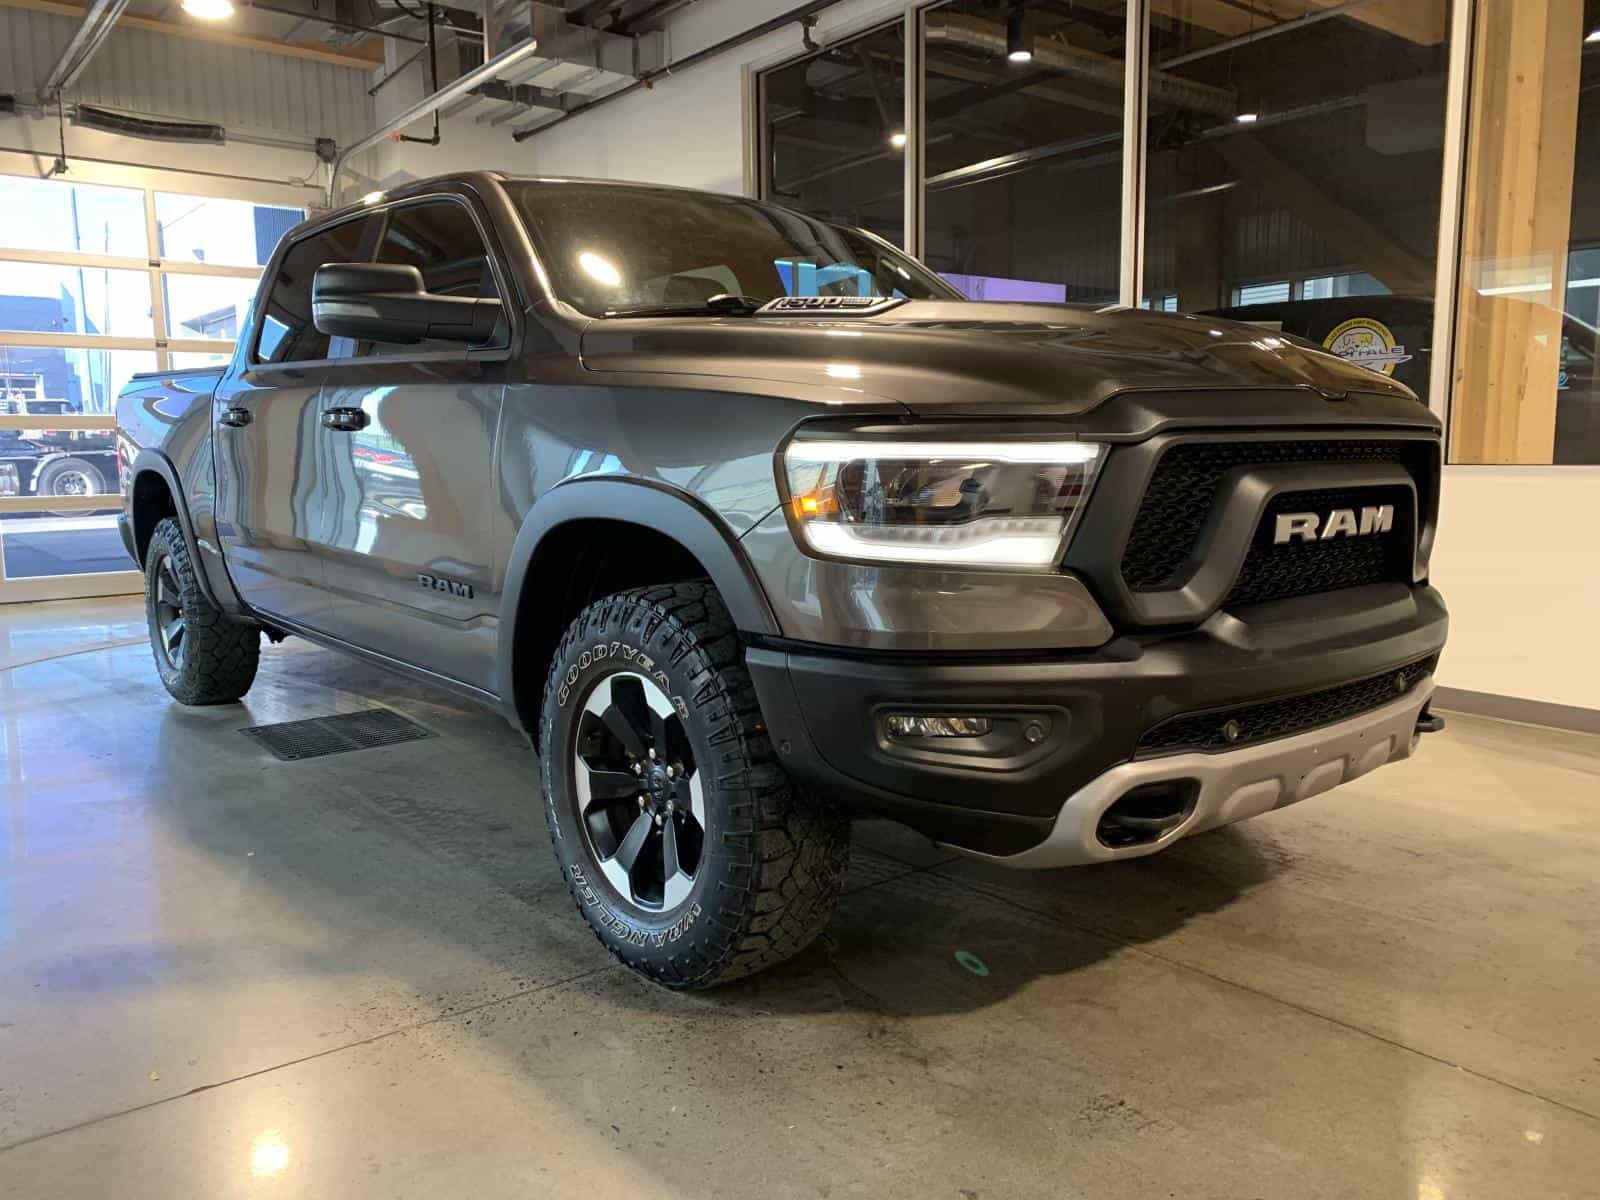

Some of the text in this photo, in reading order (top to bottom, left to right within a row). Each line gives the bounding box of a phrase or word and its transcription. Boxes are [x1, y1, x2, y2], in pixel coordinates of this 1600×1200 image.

[1273, 504, 1395, 545] RAM
[417, 573, 474, 600] RAM
[557, 641, 690, 720] GOODYEAR
[569, 863, 703, 948] WRANGLER
